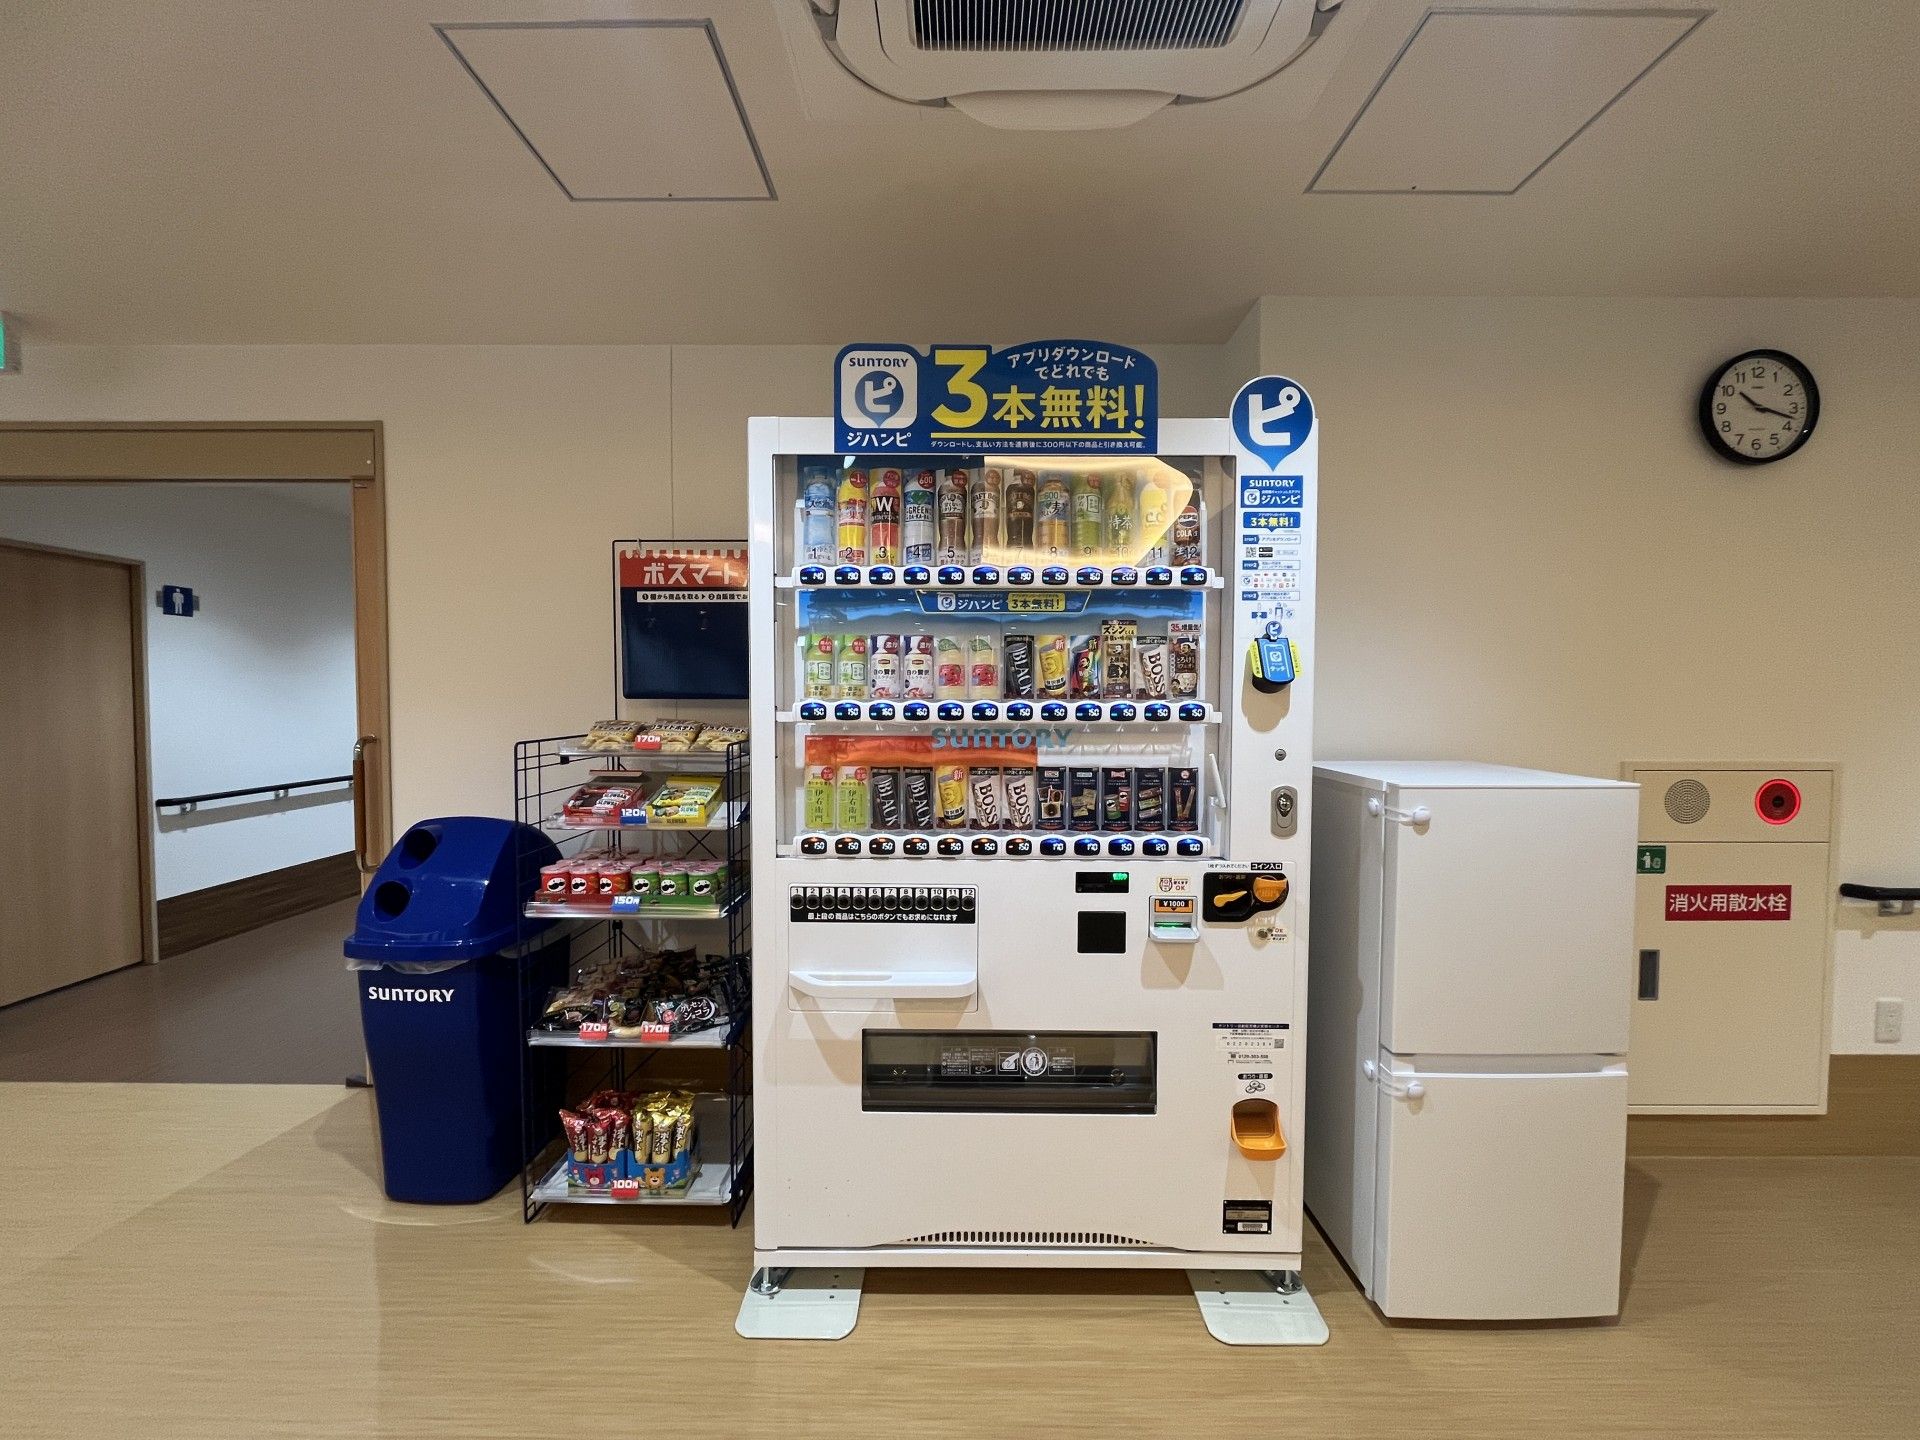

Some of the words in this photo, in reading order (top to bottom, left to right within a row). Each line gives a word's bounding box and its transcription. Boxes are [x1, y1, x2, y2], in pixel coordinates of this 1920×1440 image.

[849, 357, 908, 368] SUNTORY
[1007, 347, 1136, 369] アプリダウンロード
[1034, 365, 1110, 381] でどれでも
[1735, 372, 1746, 384] 11
[1751, 366, 1765, 379] 12
[1773, 372, 1778, 383] 1
[1721, 385, 1735, 397] 10
[1783, 384, 1793, 396] 2
[1716, 403, 1727, 415] 9
[1789, 402, 1798, 414] 3
[1721, 421, 1731, 433] 8
[1782, 421, 1792, 431] 4
[847, 432, 912, 447] ジハンピ
[1735, 434, 1745, 446] 7
[1751, 438, 1761, 451] 6
[1769, 433, 1779, 446] 5
[1249, 479, 1295, 487] SUNTORY
[876, 497, 894, 512] W
[1261, 495, 1301, 504] ジハンピ
[908, 506, 929, 514] GREEN
[1177, 530, 1193, 538] COLA
[845, 546, 853, 559] 2
[879, 546, 887, 558] 3
[913, 546, 921, 558] 4
[947, 546, 955, 558] 5
[1151, 547, 1163, 558] 11
[643, 562, 739, 584] ボスマート
[1011, 598, 1060, 610] 3本無料!
[1013, 646, 1033, 695] BLACK
[1147, 652, 1165, 693] BOSS
[931, 727, 1073, 749] SUNTORY
[878, 778, 899, 826] BLACK
[911, 777, 932, 827] BLACK
[980, 783, 998, 824] BOSS
[1014, 783, 1032, 824] BOSS
[848, 842, 859, 850] 150
[882, 842, 893, 850] 150
[1122, 843, 1132, 851] 150
[1669, 893, 1788, 912] 消火用散水栓
[807, 912, 958, 921] 最上段の商品はこちらのボタンでもお求めになれます
[368, 986, 455, 1002] SUNTORY
